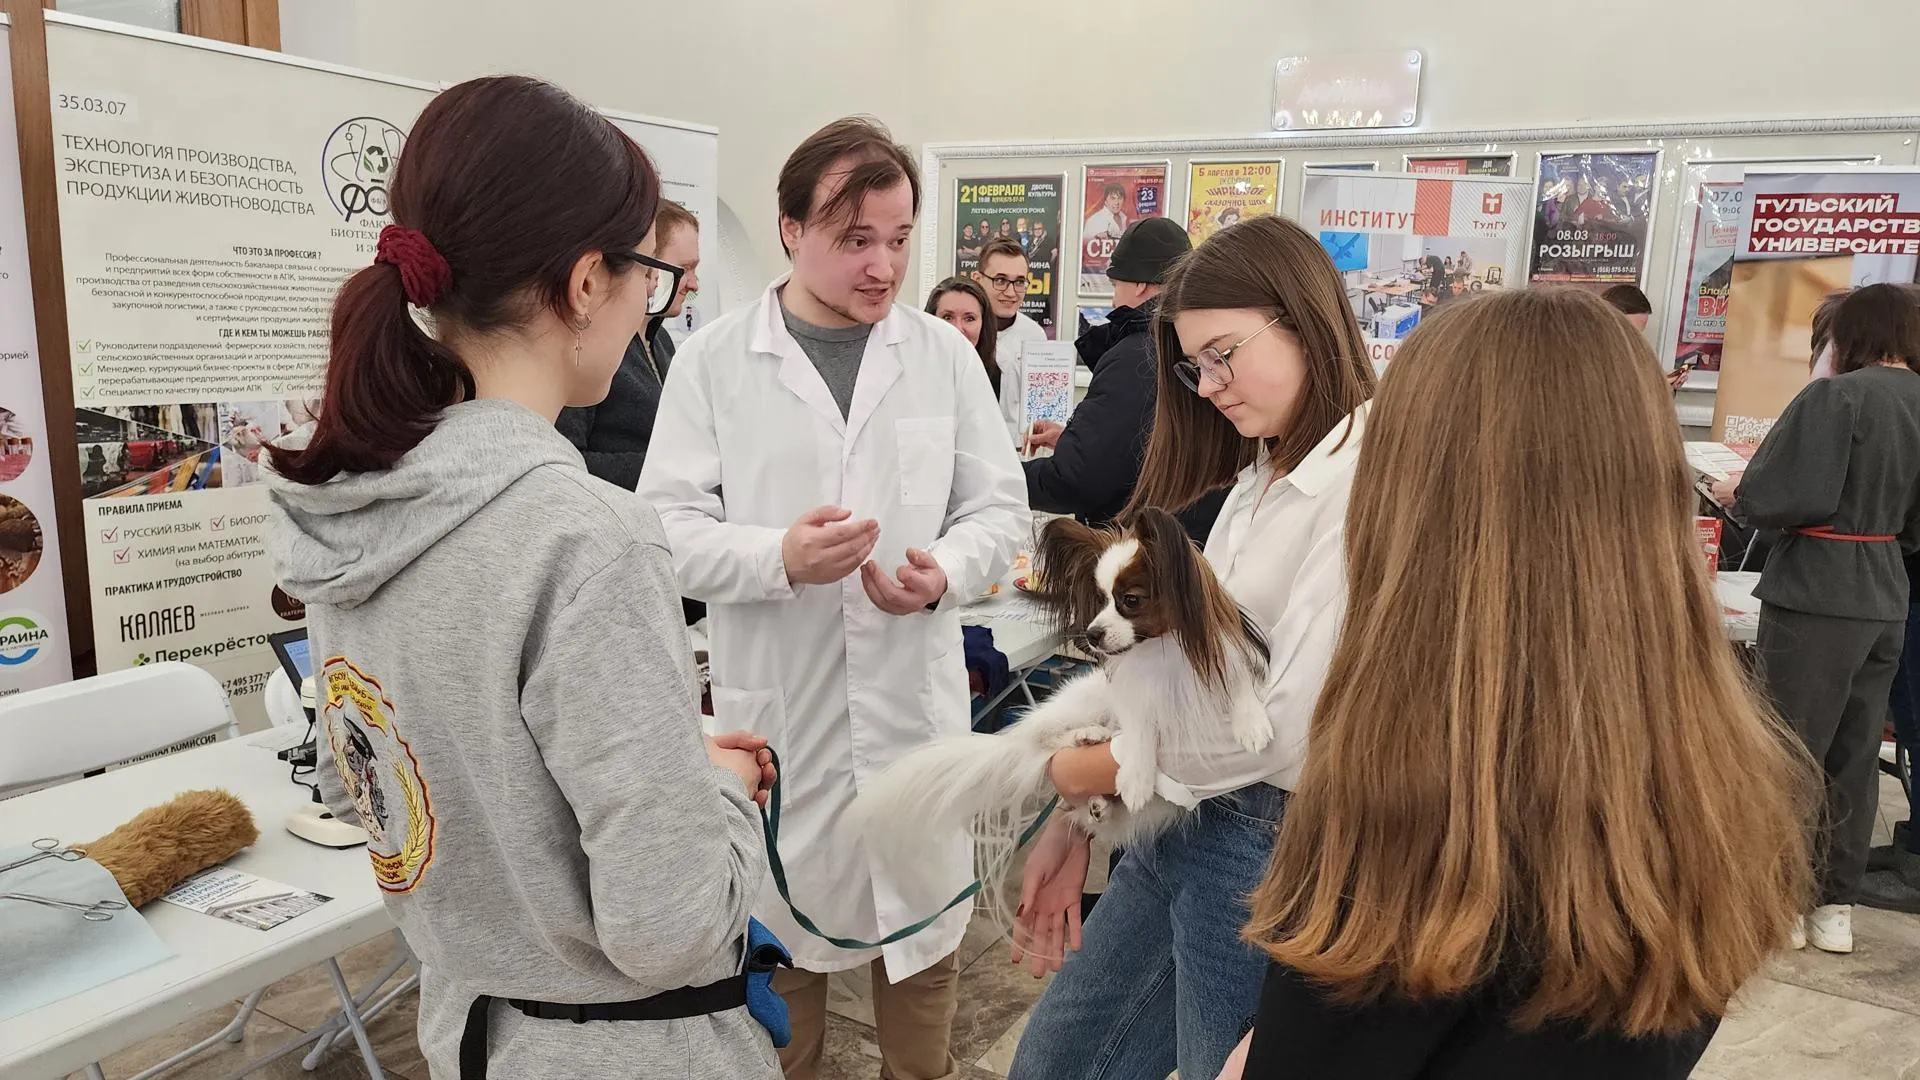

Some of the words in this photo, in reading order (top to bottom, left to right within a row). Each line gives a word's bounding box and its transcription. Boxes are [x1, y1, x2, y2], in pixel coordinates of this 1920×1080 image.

[58, 94, 127, 116] 35.03.07
[62, 134, 174, 161] ТЕХНОЛОГИЯ
[178, 147, 297, 176] ПРОИЗВОДСТВА,
[64, 157, 172, 184] ЭКСПЕРТИЗА
[175, 168, 187, 184] И
[189, 169, 304, 195] БЕЗОПАСНОСТЬ
[1198, 167, 1206, 177] 5
[1207, 169, 1235, 177] АПРЕЛЯ
[1242, 165, 1271, 176] 12:00
[961, 184, 978, 203] 21
[978, 183, 1026, 197] ФЕВРАЛЯ
[1031, 183, 1054, 192] ДВОРЕЦ
[66, 180, 172, 206] ПРОДУКЦИИ
[175, 190, 315, 216] ЖИВОТНОВОДСТВА
[1140, 189, 1154, 201] 23
[970, 207, 999, 215] ЛЕГЕНДЫ
[1755, 194, 1896, 214] ТУЛЬСКИЙ
[1472, 220, 1508, 231] ТулГУ
[1556, 229, 1589, 241] 08.03
[233, 246, 247, 255] ЧТО
[249, 248, 263, 256] ЭТО
[264, 248, 273, 257] ЗА
[275, 248, 317, 260] ПРОФЕССИЯ
[1539, 243, 1635, 258] РОЗЫГРЫШ
[105, 252, 188, 266] Профессиональная
[189, 259, 243, 268] деятельность
[245, 260, 284, 270] бакалавра
[113, 266, 171, 276] предприятий
[192, 269, 215, 278] форм
[216, 270, 272, 280] собственности
[76, 276, 140, 286] производства
[153, 279, 200, 289] разведения
[202, 281, 289, 292] сельскохозяйственных
[91, 287, 145, 298] безопасной
[153, 290, 243, 301] конкурентоспособной
[112, 300, 163, 311] закупочной
[164, 301, 207, 311] логистики,
[215, 304, 238, 312] также
[244, 304, 298, 313] руководством
[202, 314, 259, 323] сертификации
[260, 316, 300, 324] продукции
[219, 328, 234, 338] ГДЕ
[234, 329, 241, 337] И
[241, 328, 258, 338] КЕМ
[259, 329, 271, 338] ТЫ
[271, 329, 307, 338] МОЖЕШЬ
[95, 341, 158, 351] Руководители
[159, 341, 222, 350] подразделений
[225, 342, 272, 351] фермерских
[96, 353, 194, 362] сельскохозяйственных
[195, 353, 246, 362] организаций
[148, 363, 202, 374] курирующий
[203, 363, 265, 372] бизнес-проекты
[272, 363, 295, 372] сфере
[99, 375, 184, 386] перерабатывающие
[98, 387, 151, 397] Специалист
[165, 387, 200, 395] качеству
[202, 386, 245, 395] продукции
[246, 384, 262, 392] АПК
[98, 502, 144, 516] ПРАВИЛА
[146, 499, 183, 513] ПРИЕМА
[123, 522, 172, 540] РУССКИЙ
[173, 521, 201, 535] ЯЗЫК
[137, 546, 175, 560] ХИМИЯ
[177, 545, 197, 555] или
[175, 555, 189, 568] (на
[190, 552, 219, 568] выбор
[104, 582, 154, 597] ПРАКТИКА
[155, 581, 163, 591] И
[164, 568, 242, 590] ТРУДОУСТРОЙСТВО
[120, 604, 195, 642] КАЛЯЕВ
[233, 676, 248, 688] 495
[233, 685, 248, 697] 495
